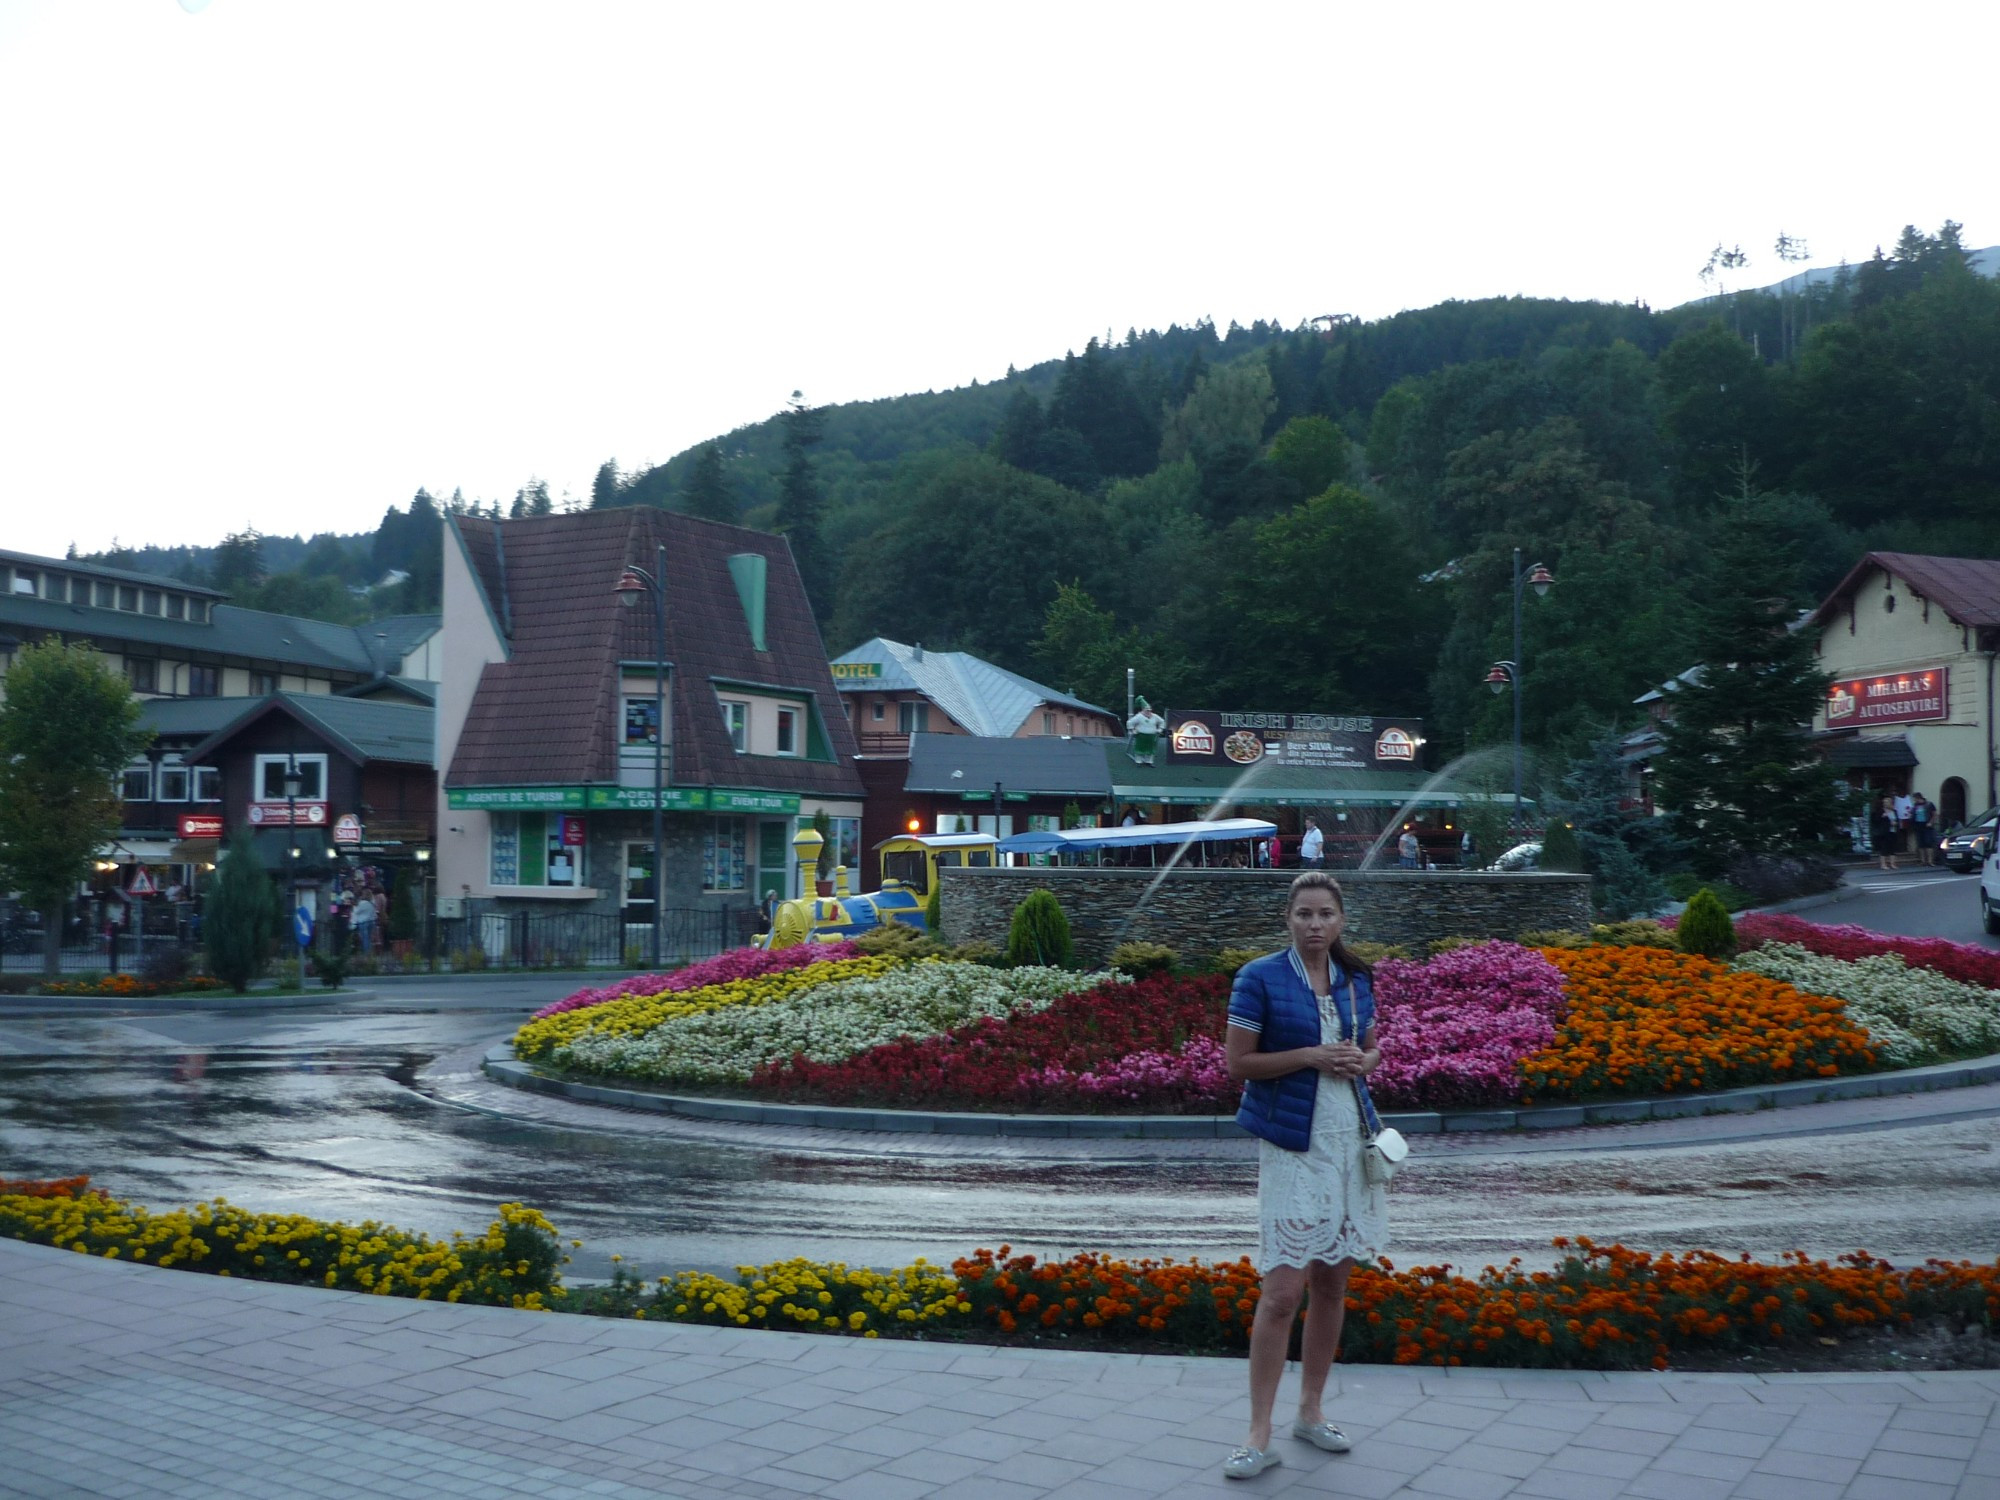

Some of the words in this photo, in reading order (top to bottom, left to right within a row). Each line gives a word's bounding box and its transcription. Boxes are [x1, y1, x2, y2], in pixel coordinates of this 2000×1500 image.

[831, 664, 876, 678] OTEL
[1867, 678, 1931, 697] MIHAELA'S
[1860, 698, 1940, 717] AUTOSERVIRE
[1221, 713, 1286, 728] IRISH
[1292, 715, 1373, 733] HOUSE
[1177, 737, 1210, 749] SILVA
[1309, 742, 1332, 751] SILVA
[1379, 743, 1410, 756] SILVA
[1305, 758, 1326, 766] PIZZA
[465, 792, 508, 803] AGENTIE
[510, 792, 525, 802] DE
[527, 791, 565, 801] TURISM
[616, 790, 682, 799] AGENTIE
[731, 796, 760, 807] EVENT
[761, 797, 782, 808] TOUR
